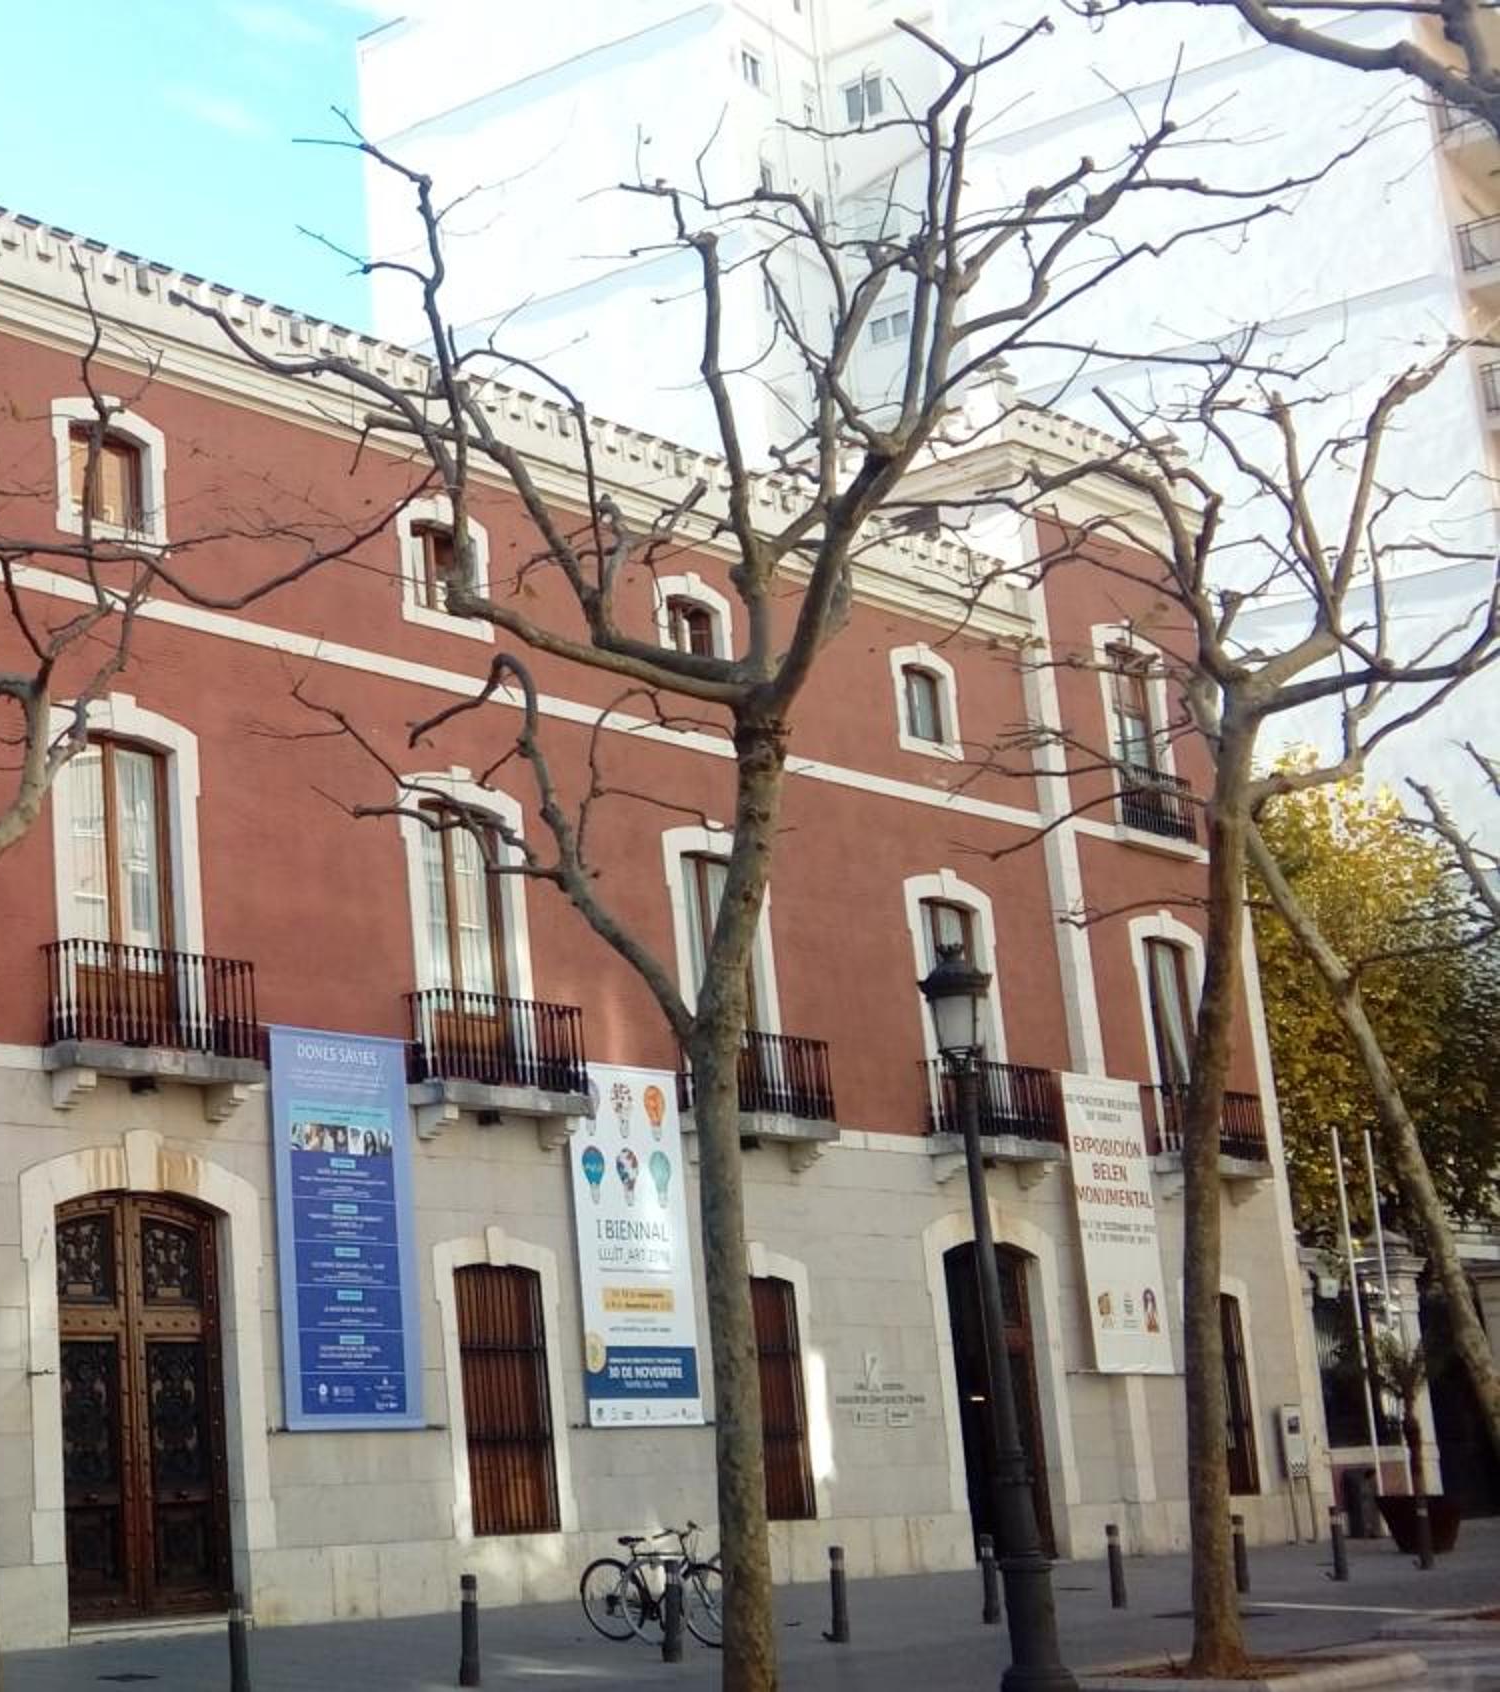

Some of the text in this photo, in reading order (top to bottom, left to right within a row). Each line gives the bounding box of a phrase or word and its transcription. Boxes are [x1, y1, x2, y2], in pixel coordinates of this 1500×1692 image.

[297, 1042, 337, 1061] DONES
[1073, 1135, 1141, 1157] EXPOSICIÓN
[1077, 1185, 1154, 1209] MONUMENTAL
[605, 1219, 669, 1242] BIENNAL
[634, 1366, 683, 1379] NOVEMBRE
